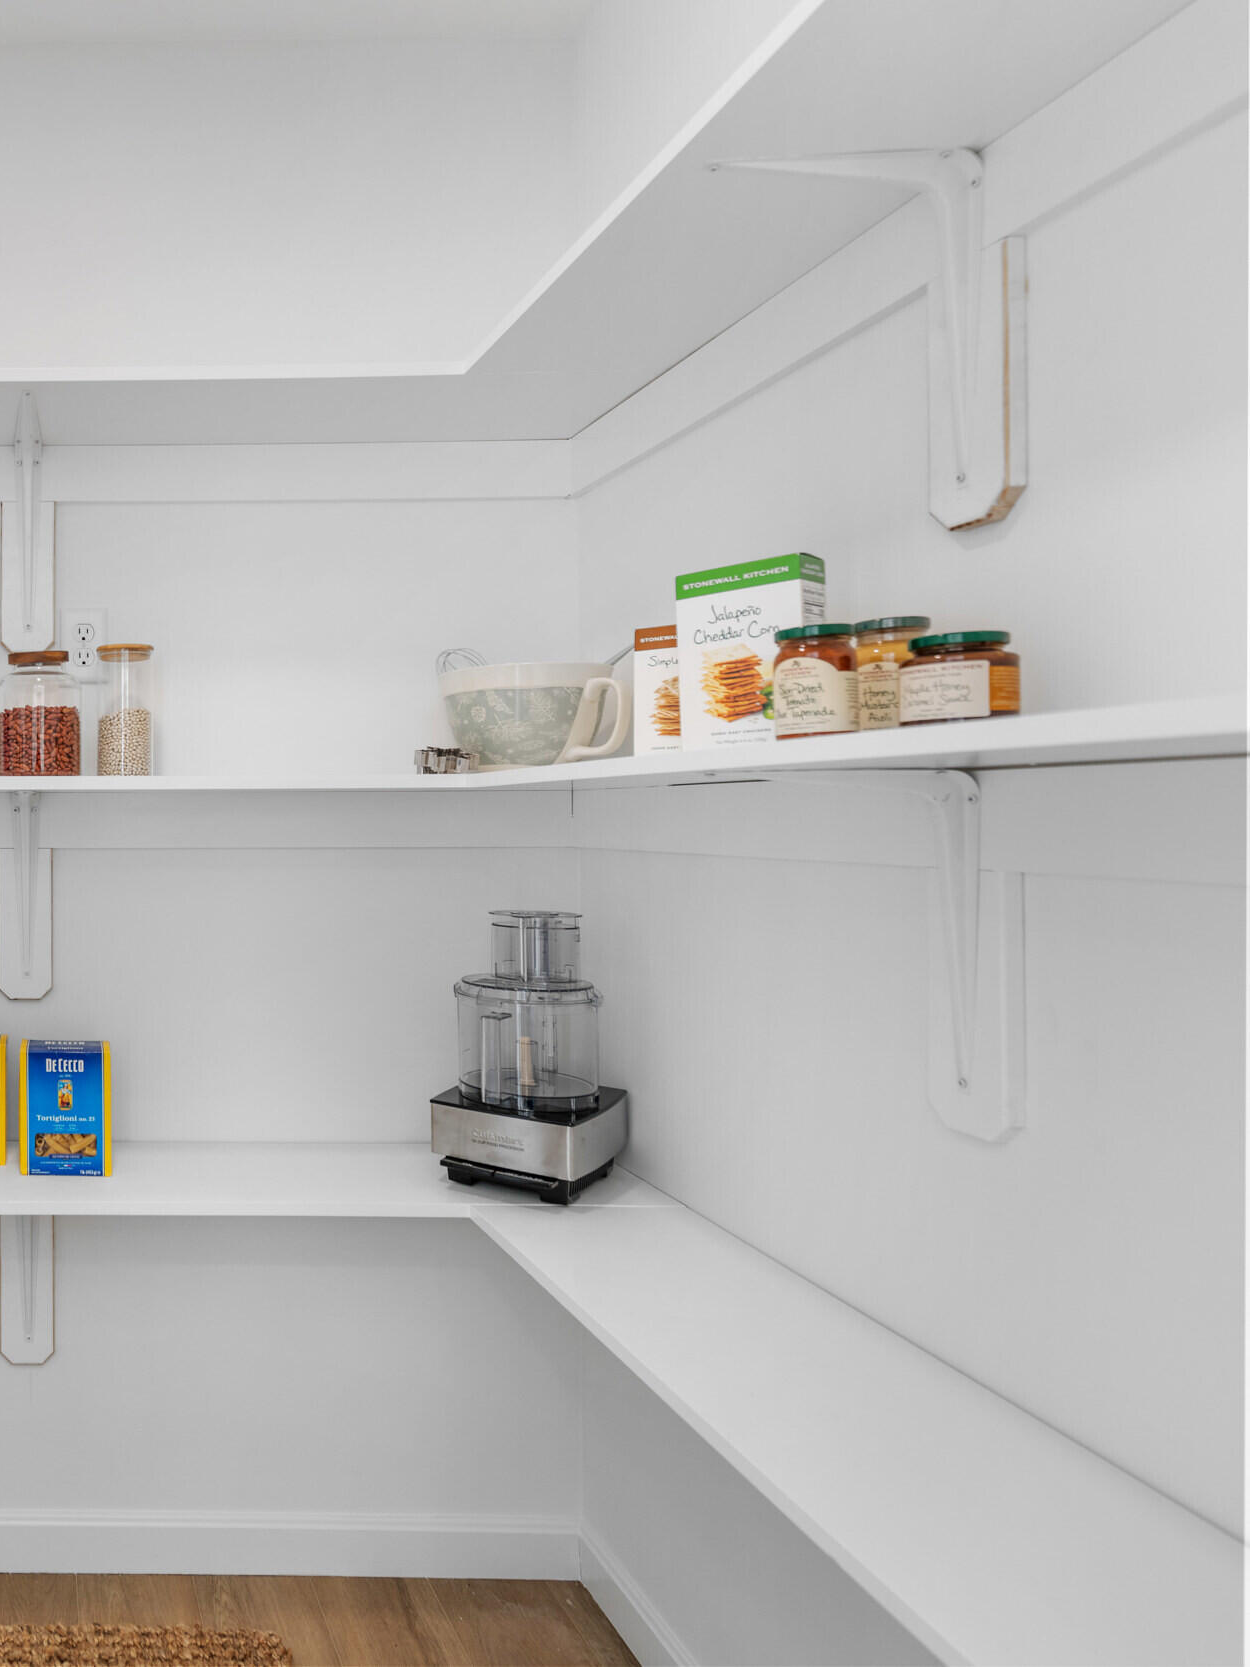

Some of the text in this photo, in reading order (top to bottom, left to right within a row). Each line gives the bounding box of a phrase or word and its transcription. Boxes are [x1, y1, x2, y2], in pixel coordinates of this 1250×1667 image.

[682, 575, 741, 591] STONEWALL
[743, 565, 789, 580] KITCHEN
[707, 604, 762, 624] Jalapeño
[693, 620, 781, 645] Cheddar Corn
[57, 1058, 84, 1072] CECCO
[36, 1114, 77, 1122] Tortiglioni
